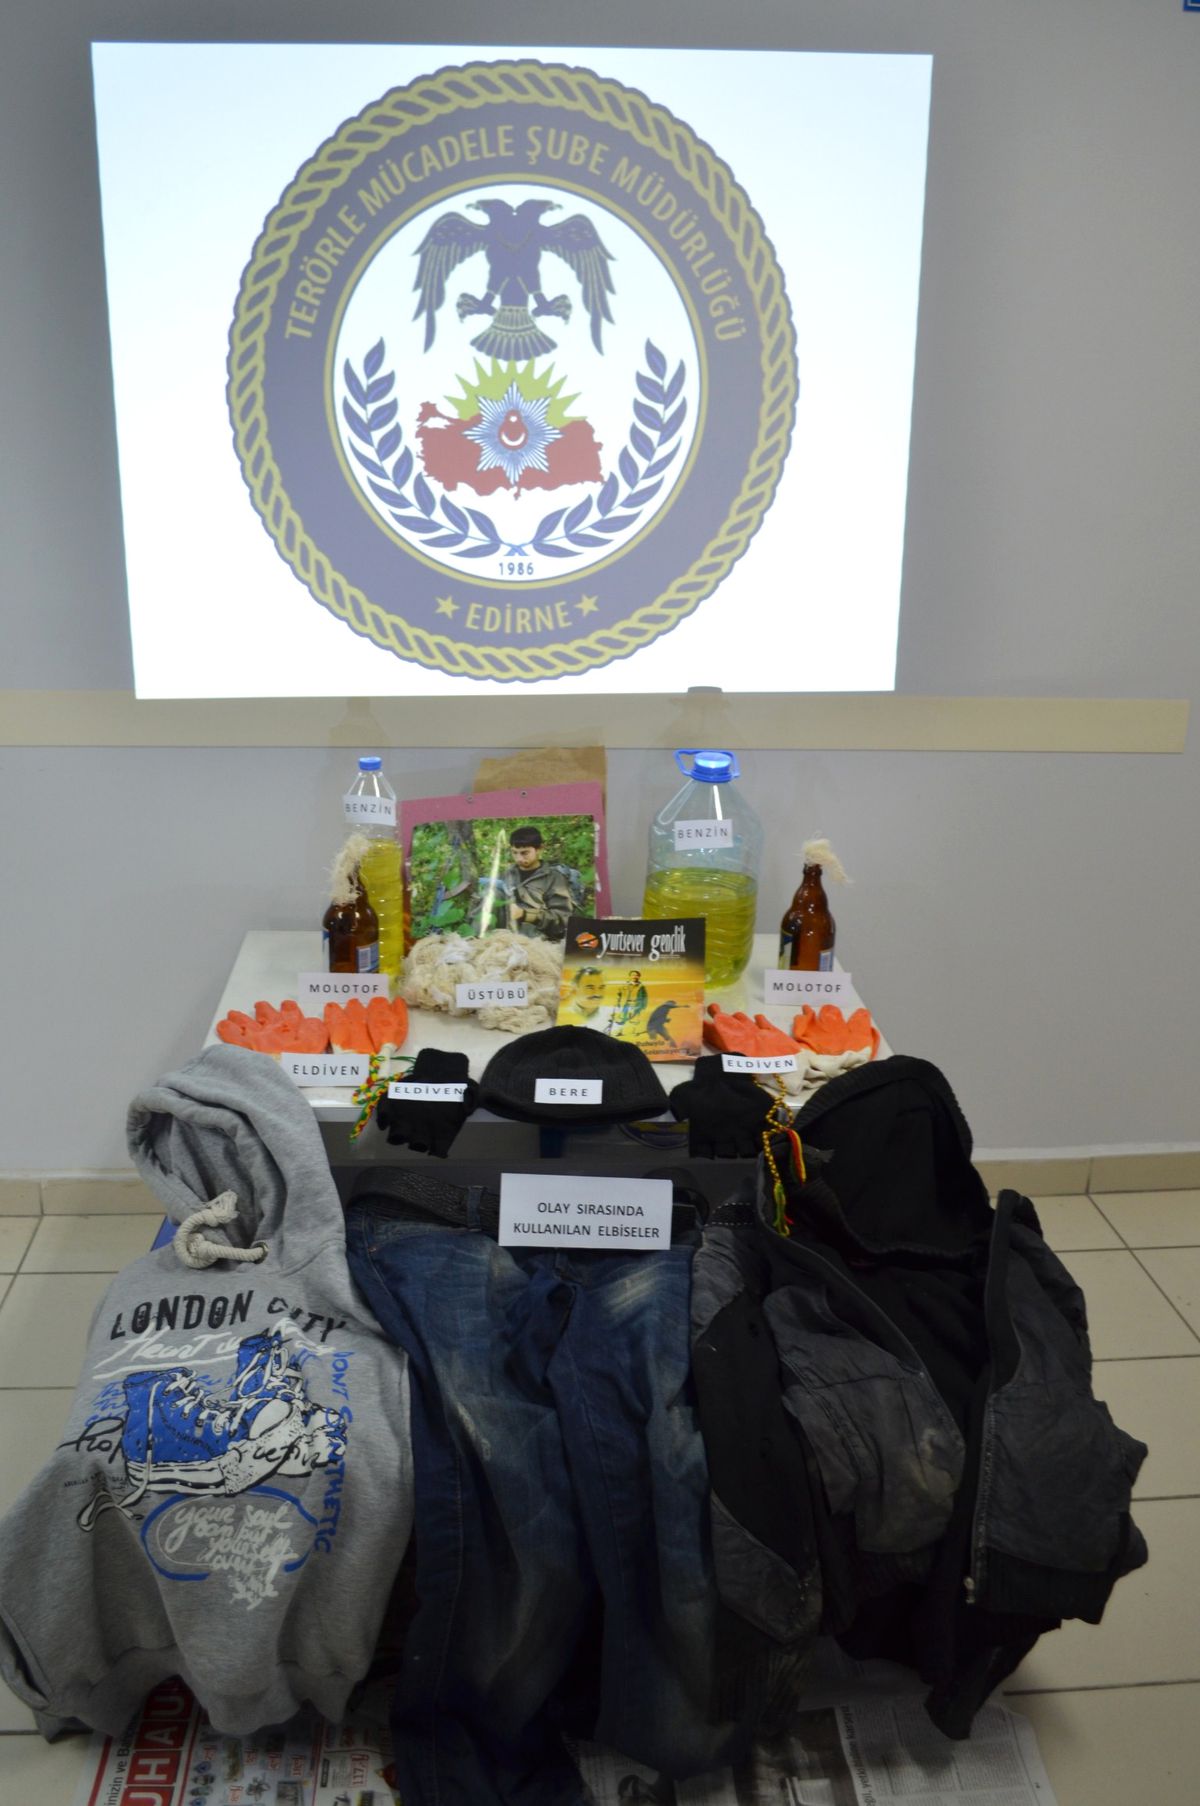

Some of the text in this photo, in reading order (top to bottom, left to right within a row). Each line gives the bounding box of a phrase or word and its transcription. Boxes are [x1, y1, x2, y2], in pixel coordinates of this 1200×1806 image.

[284, 126, 747, 343] TERÖRLE MÜCADELE ŞUBE MÜDÜRLÜĞÜ
[498, 562, 535, 576] 1986
[465, 601, 573, 635] EDİRNE
[677, 826, 730, 840] BENZİN
[596, 931, 646, 959] yurtsever
[310, 984, 379, 994] MOLOTOF
[468, 987, 525, 1000] ÜSTÜBÜ
[773, 982, 841, 993] MOLOTOF
[293, 1064, 359, 1076] ELDİVEN
[727, 1059, 793, 1069] ELDİVEN
[395, 1085, 464, 1095] ELDİVEN
[549, 1087, 588, 1097] BERE
[537, 1202, 644, 1217] OLAY SIRASINDA
[513, 1223, 660, 1239] KULLANILAN ELBİSELER
[110, 1290, 254, 1340] LONDON
